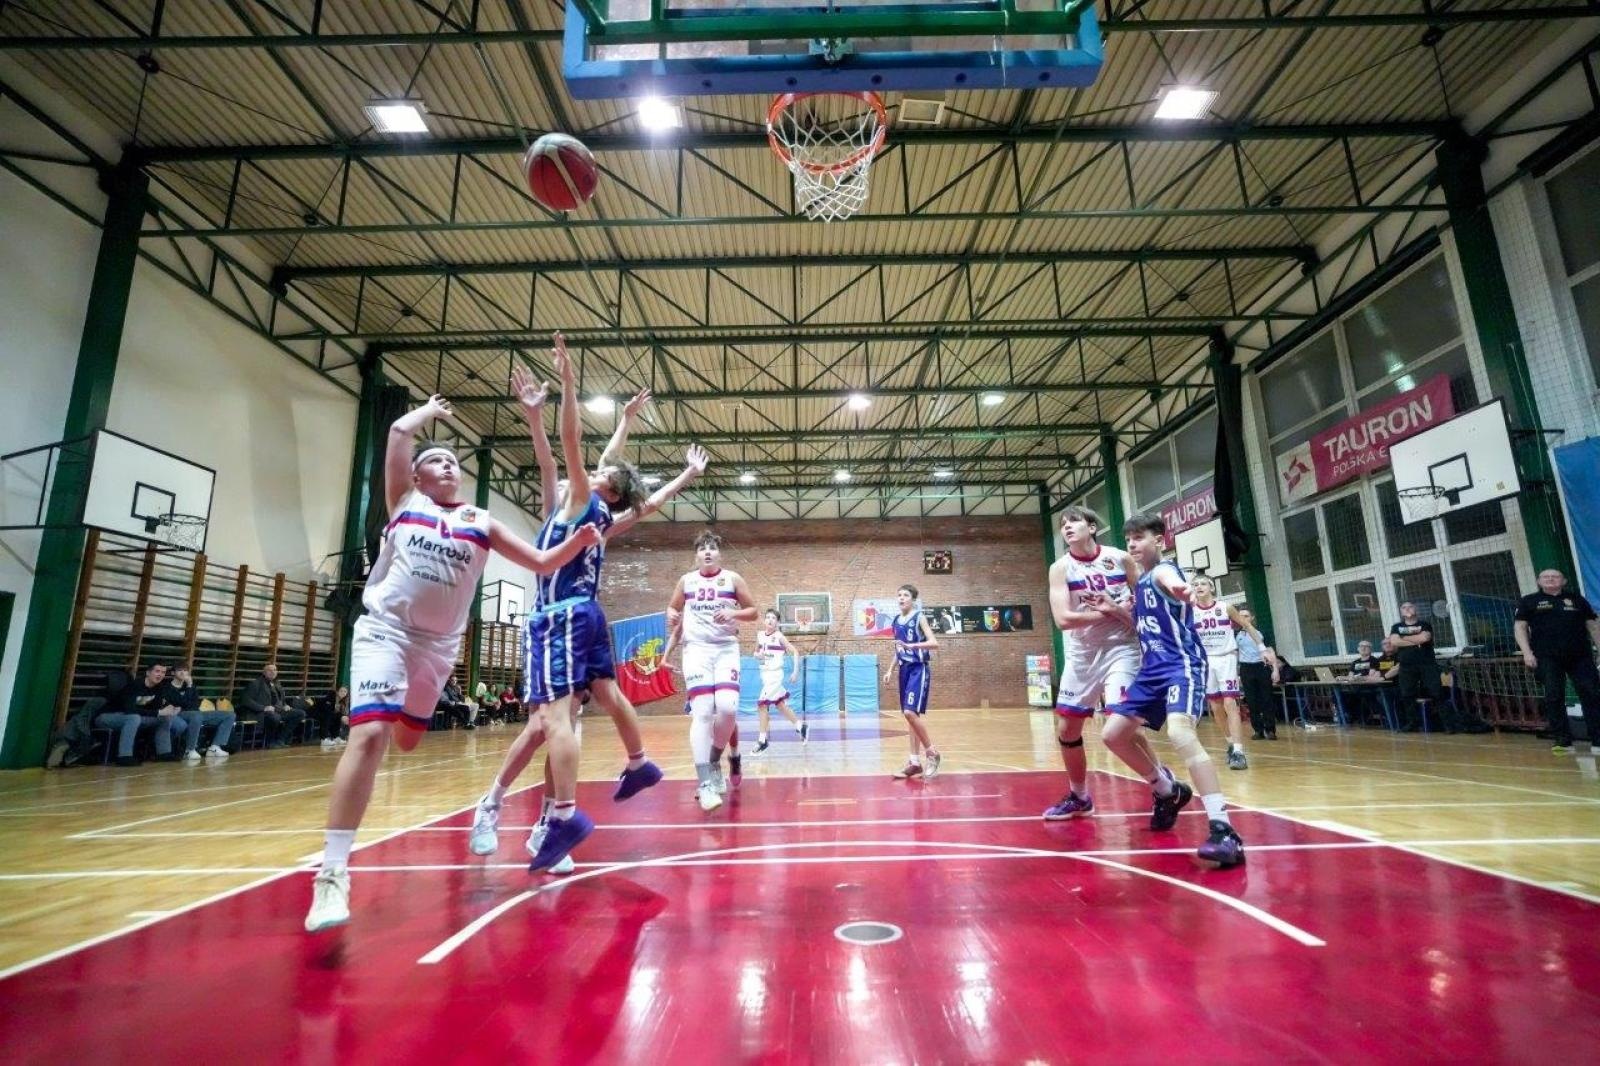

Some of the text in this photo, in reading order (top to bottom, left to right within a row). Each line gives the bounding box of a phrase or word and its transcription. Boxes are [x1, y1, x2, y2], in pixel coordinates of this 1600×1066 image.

[1322, 394, 1433, 462] TAURON
[1333, 453, 1376, 477] POLSKA
[1163, 494, 1217, 531] TAURON
[697, 588, 716, 601] 33
[1143, 588, 1158, 608] 13
[1202, 618, 1216, 629] 30
[907, 692, 915, 705] 6
